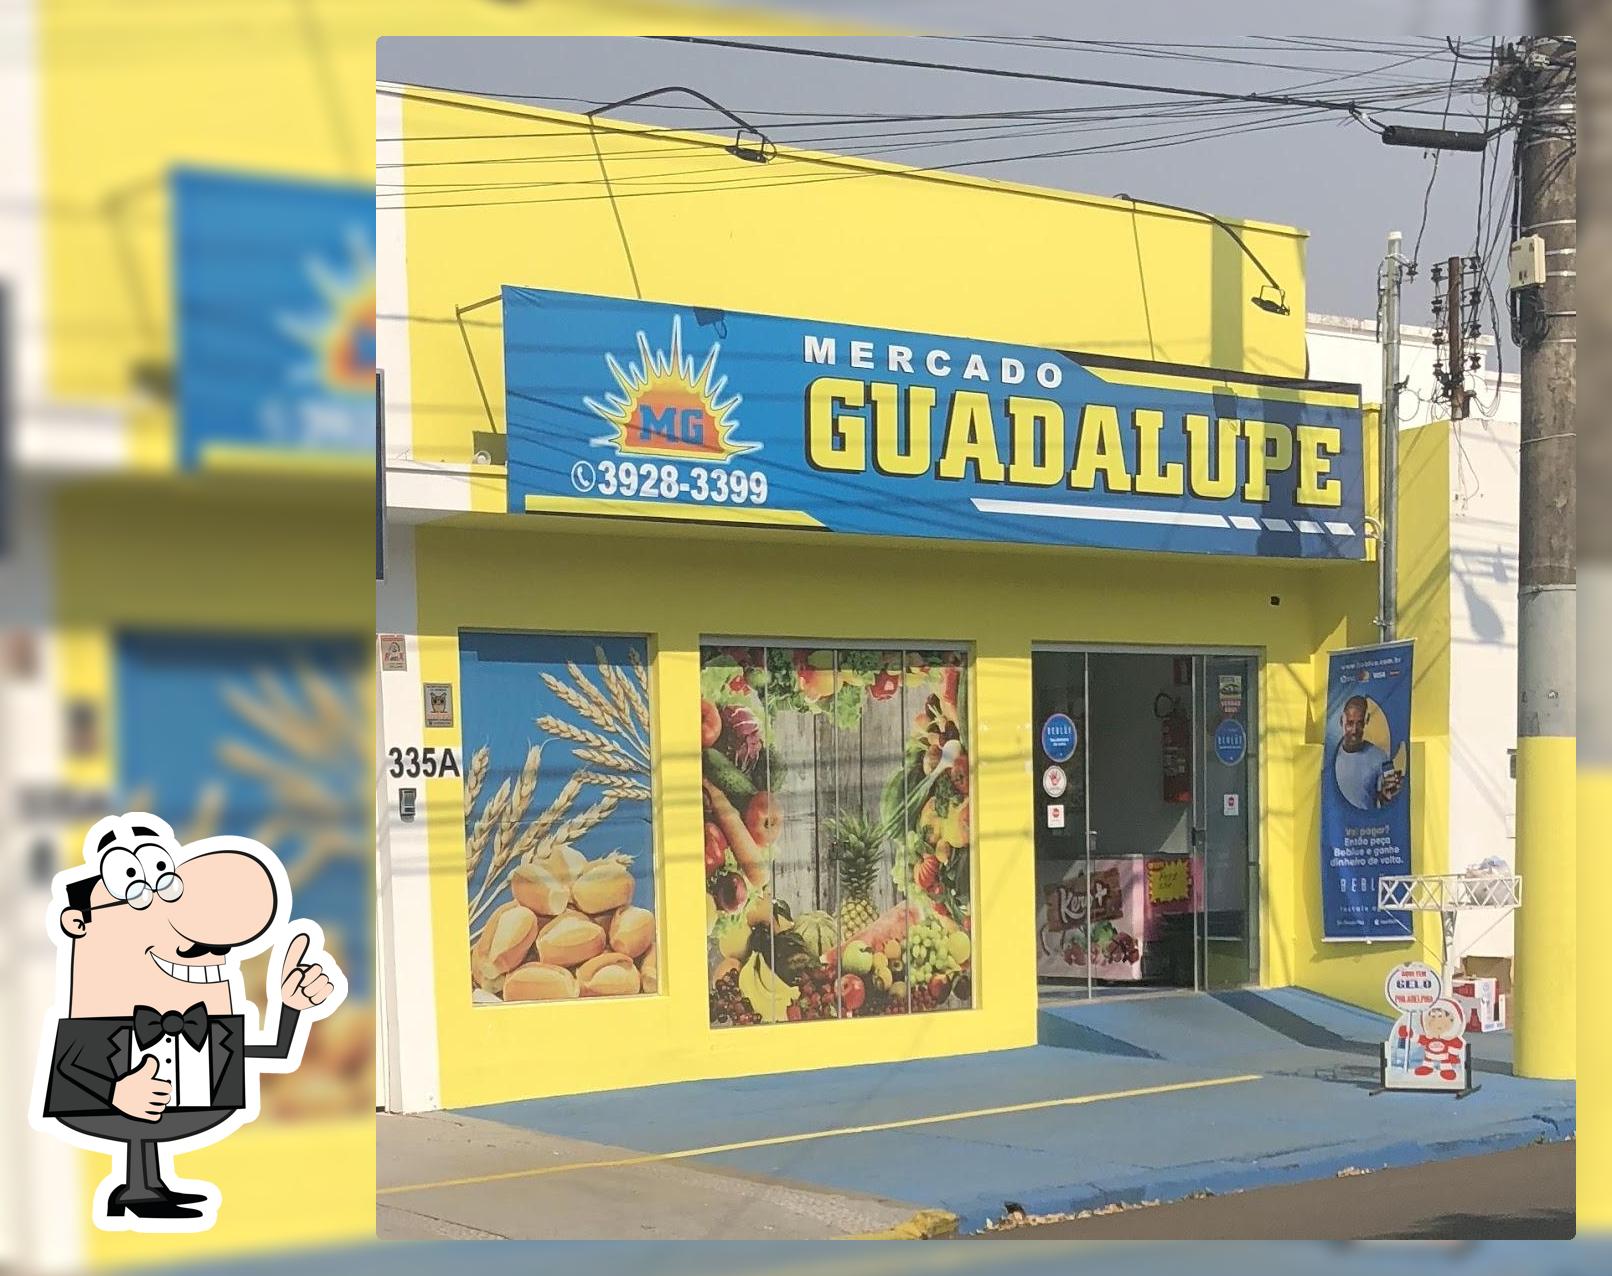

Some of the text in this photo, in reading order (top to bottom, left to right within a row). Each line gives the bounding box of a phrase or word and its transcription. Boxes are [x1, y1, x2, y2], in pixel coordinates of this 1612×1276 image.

[803, 334, 1063, 389] MERCADO
[640, 404, 704, 446] MG
[805, 377, 1342, 507] GUADALUPE
[598, 460, 769, 505] 3928-3399
[388, 747, 460, 778] 335A
[1396, 979, 1432, 989] GELO
